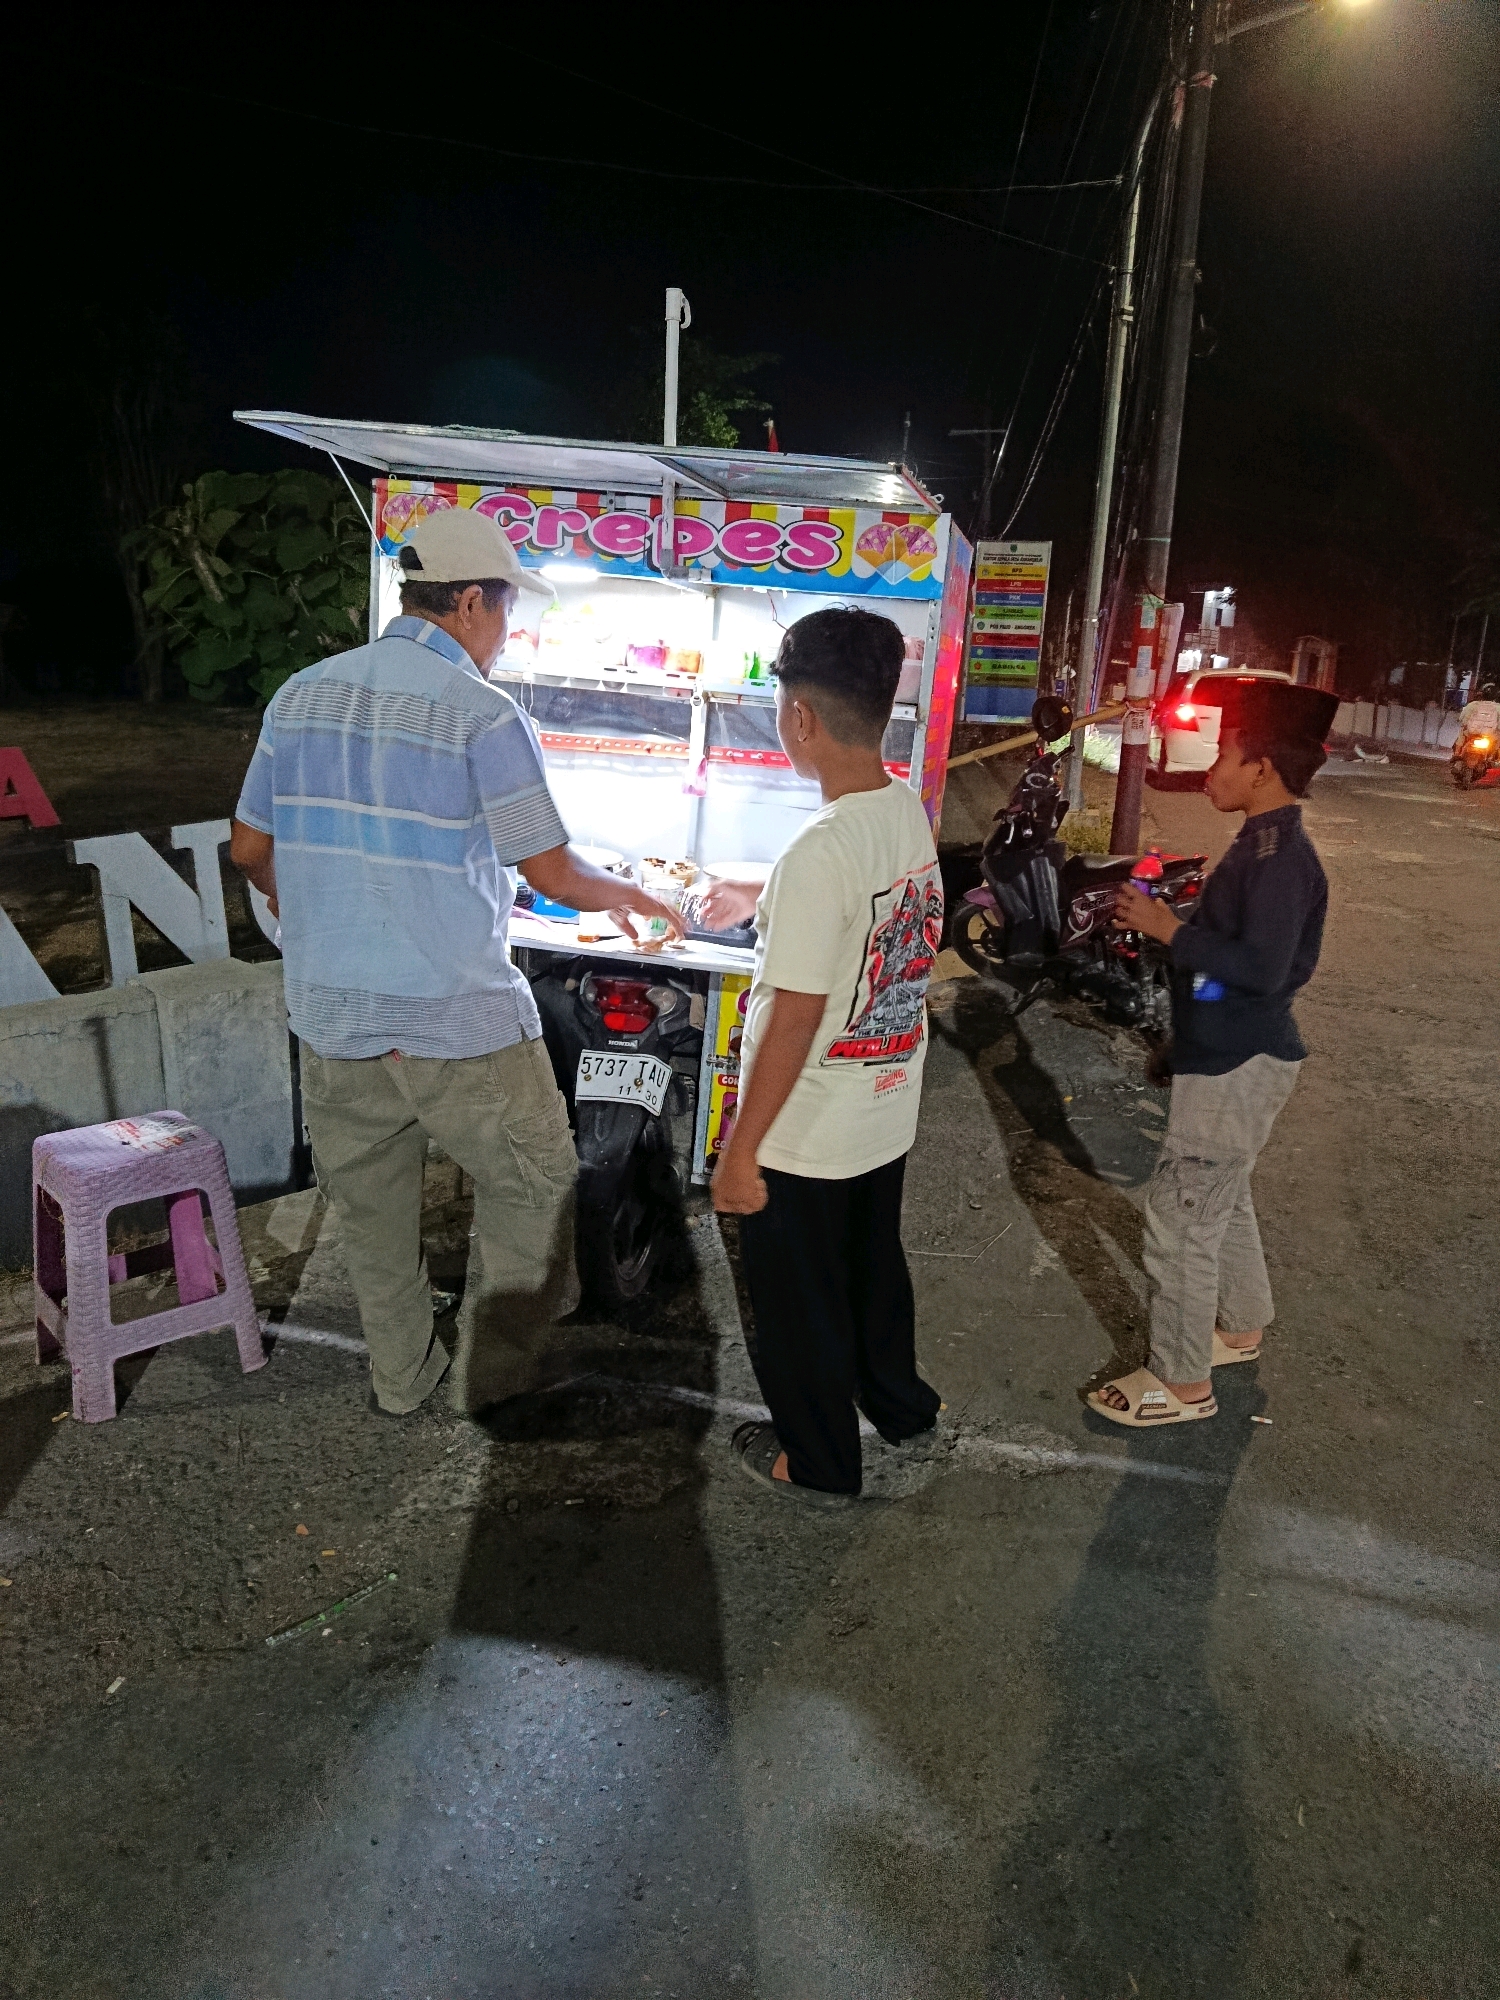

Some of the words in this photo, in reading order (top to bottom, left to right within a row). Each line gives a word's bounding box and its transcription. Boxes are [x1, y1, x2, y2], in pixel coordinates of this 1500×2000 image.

[473, 490, 844, 573] Crepes
[608, 1039, 638, 1048] HONDA
[580, 1056, 628, 1077] 5737
[639, 1061, 666, 1088] TAU
